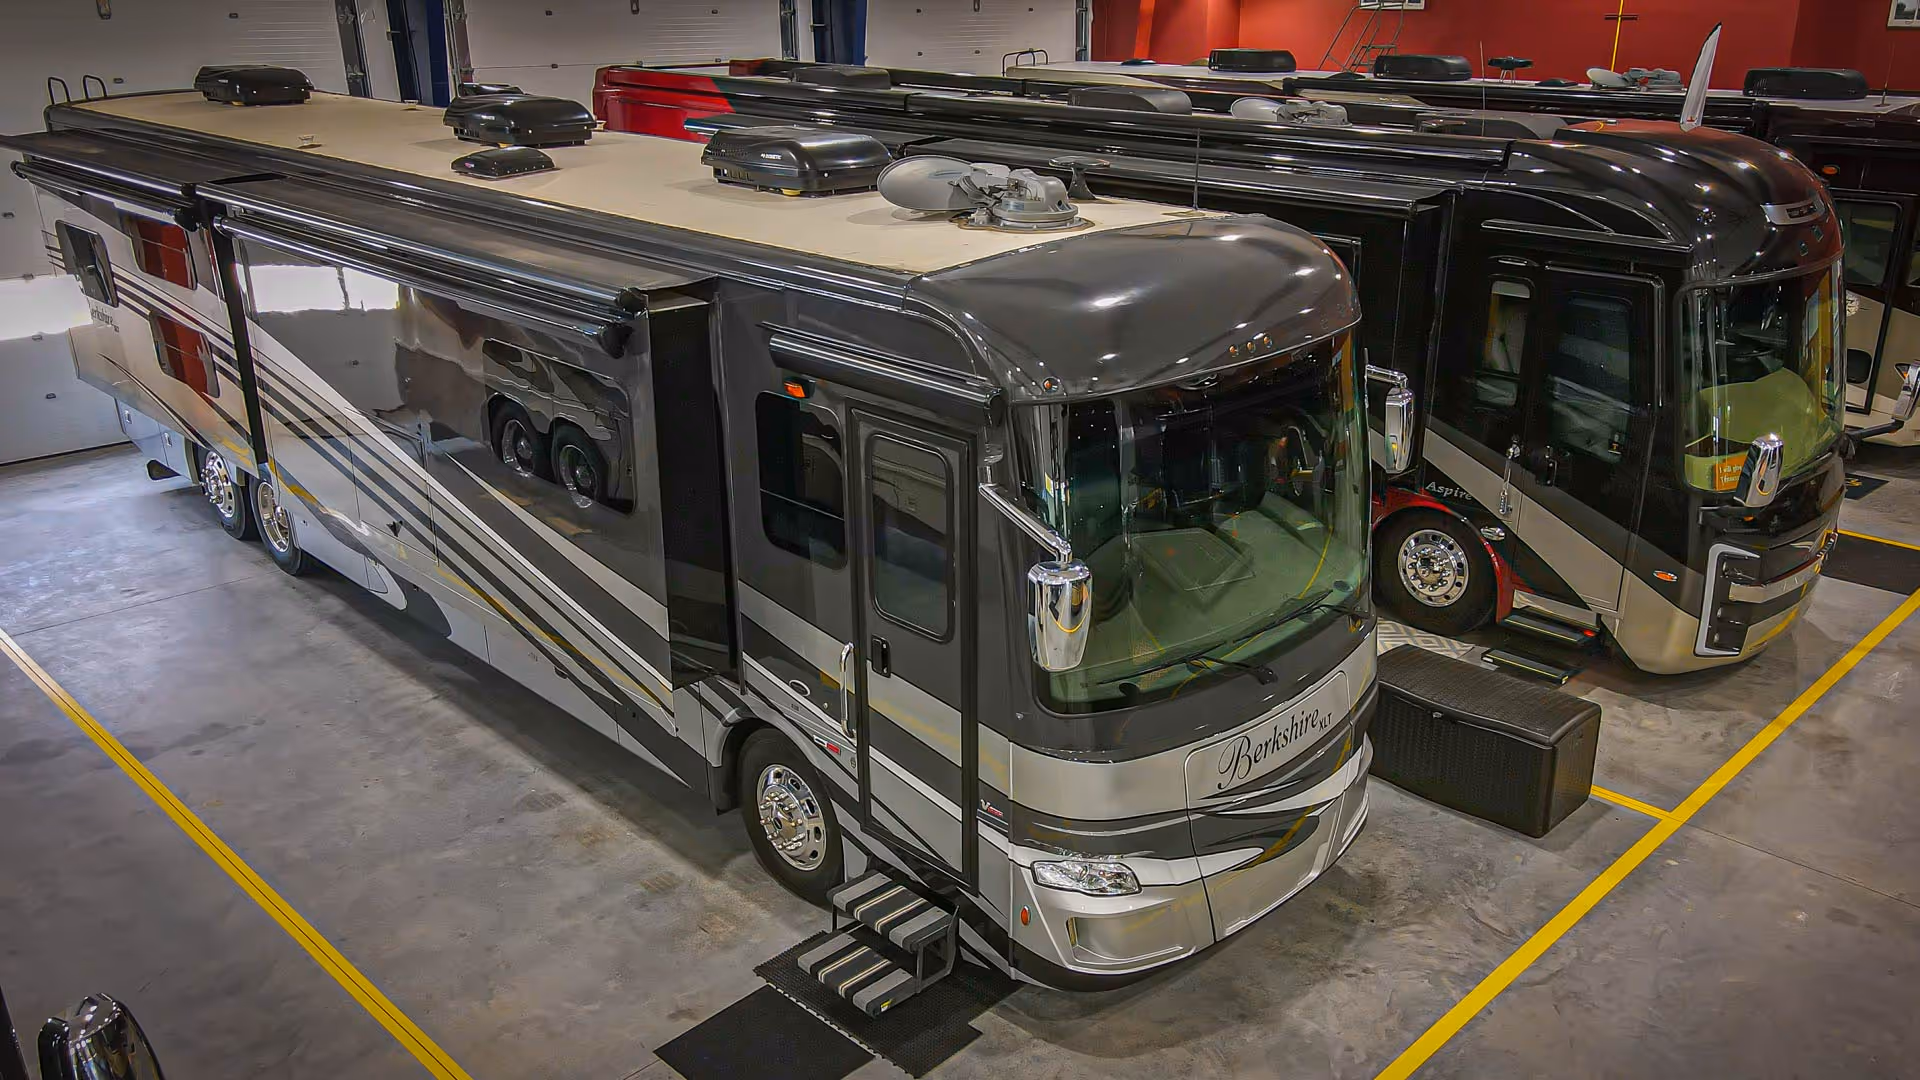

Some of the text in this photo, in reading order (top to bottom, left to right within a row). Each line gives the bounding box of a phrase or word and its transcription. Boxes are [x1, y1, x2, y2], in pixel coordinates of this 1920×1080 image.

[1425, 481, 1473, 501] Aspire
[1217, 708, 1333, 790] Berkshire XLT
